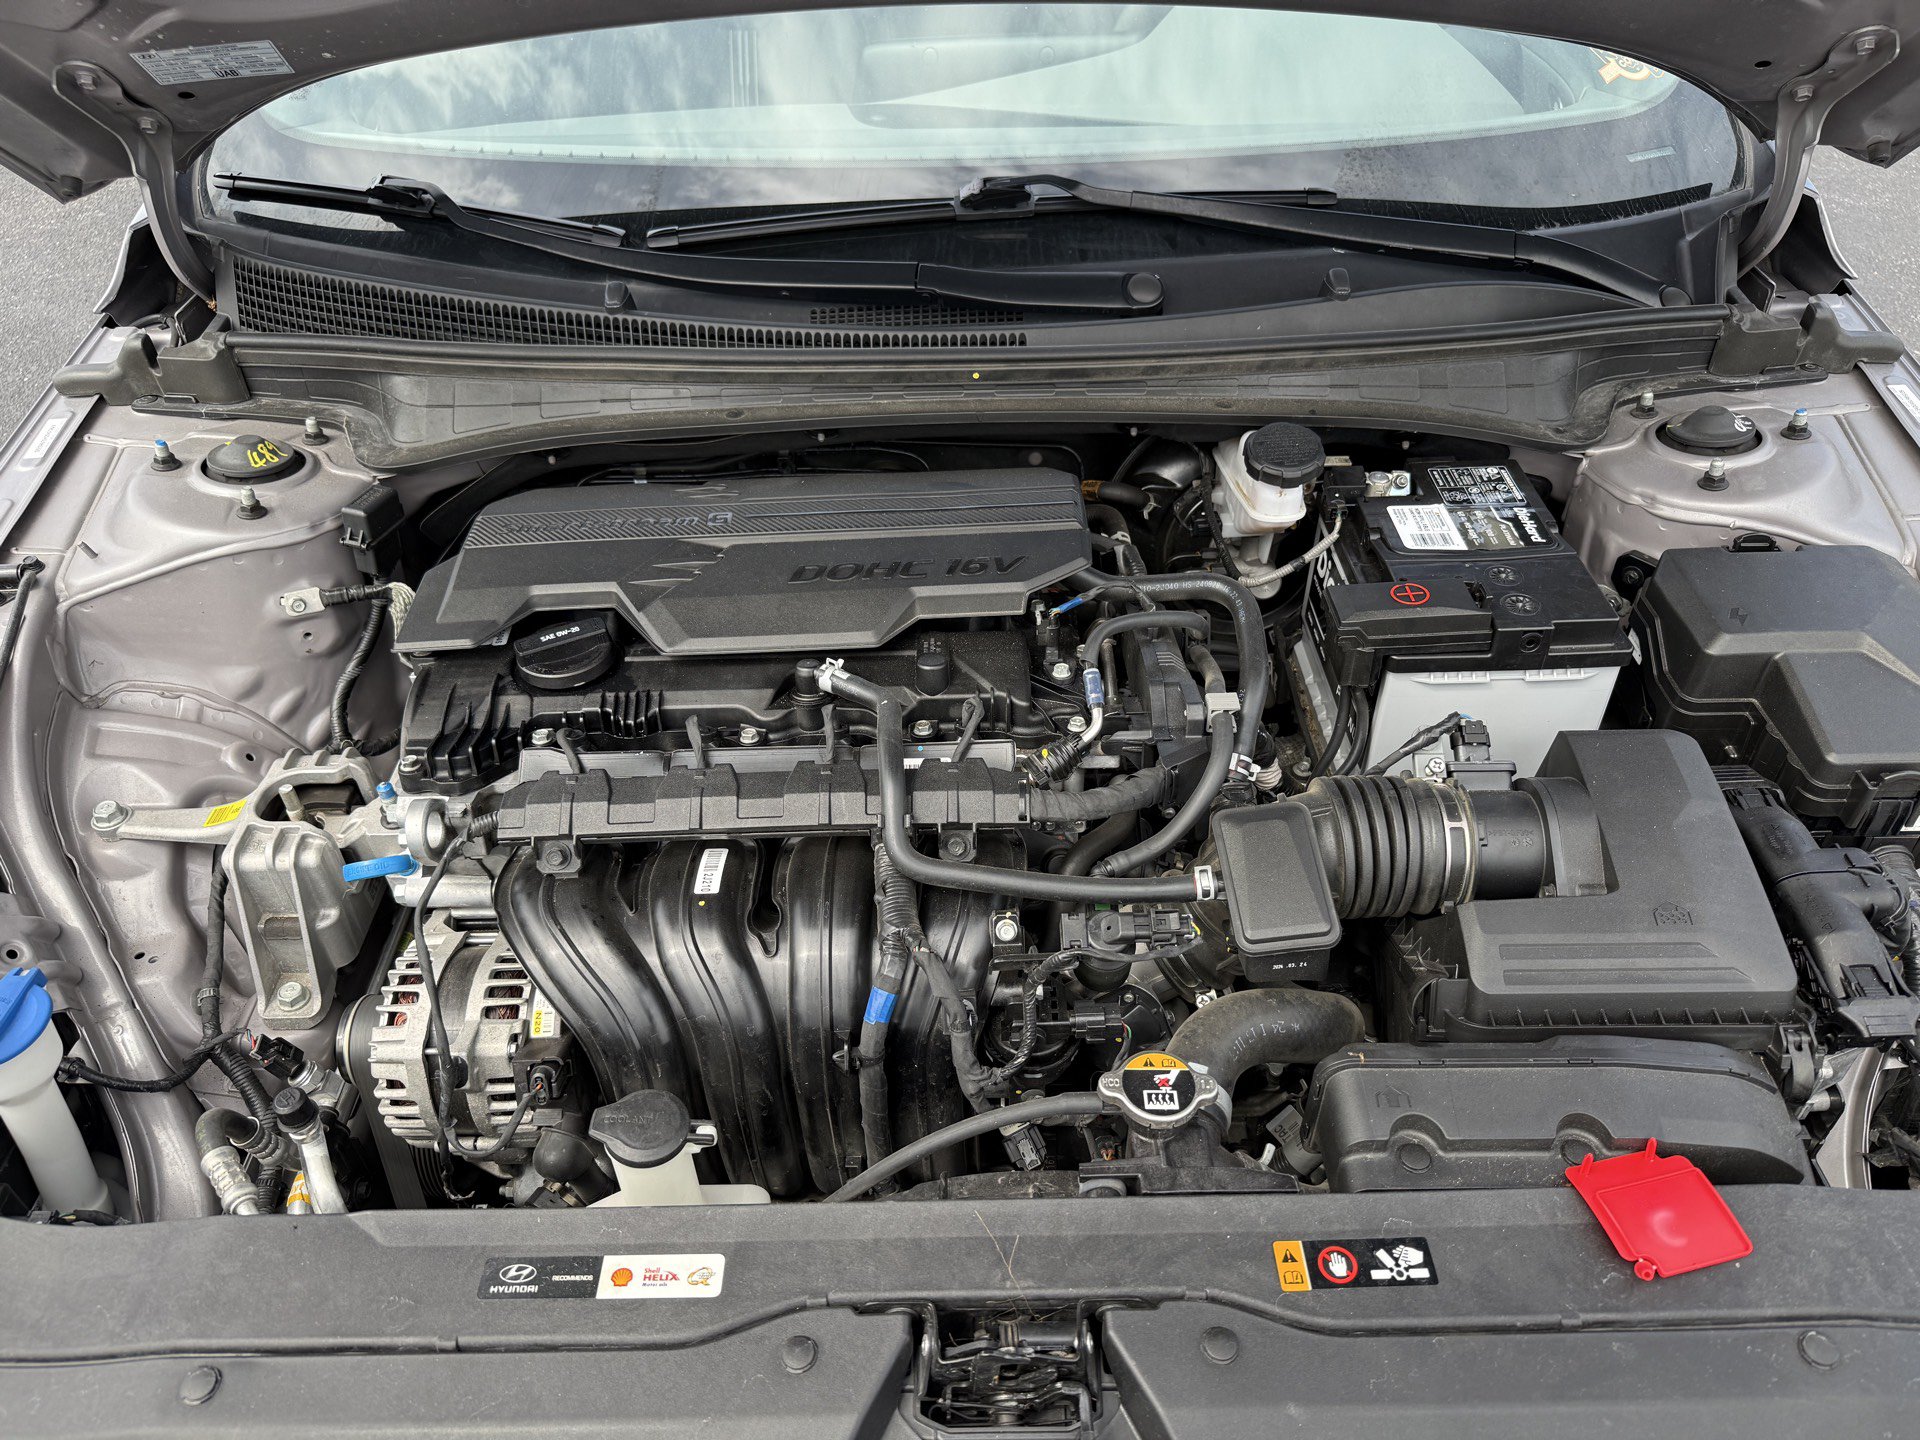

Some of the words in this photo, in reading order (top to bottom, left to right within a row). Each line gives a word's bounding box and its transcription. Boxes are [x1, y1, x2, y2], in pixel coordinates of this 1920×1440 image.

[214, 69, 240, 78] UAB
[707, 511, 733, 526] G
[1513, 507, 1546, 543] DieHard
[787, 558, 937, 585] DOHC
[944, 555, 1030, 578] 16V
[540, 633, 556, 642] SAE
[556, 626, 580, 637] 0W-20
[374, 861, 389, 870] OIL
[603, 1113, 654, 1124] COOLANT
[551, 1274, 594, 1282] RECOMMENDS
[643, 1270, 681, 1282] HELIX
[489, 1284, 539, 1294] HYUNDAI
